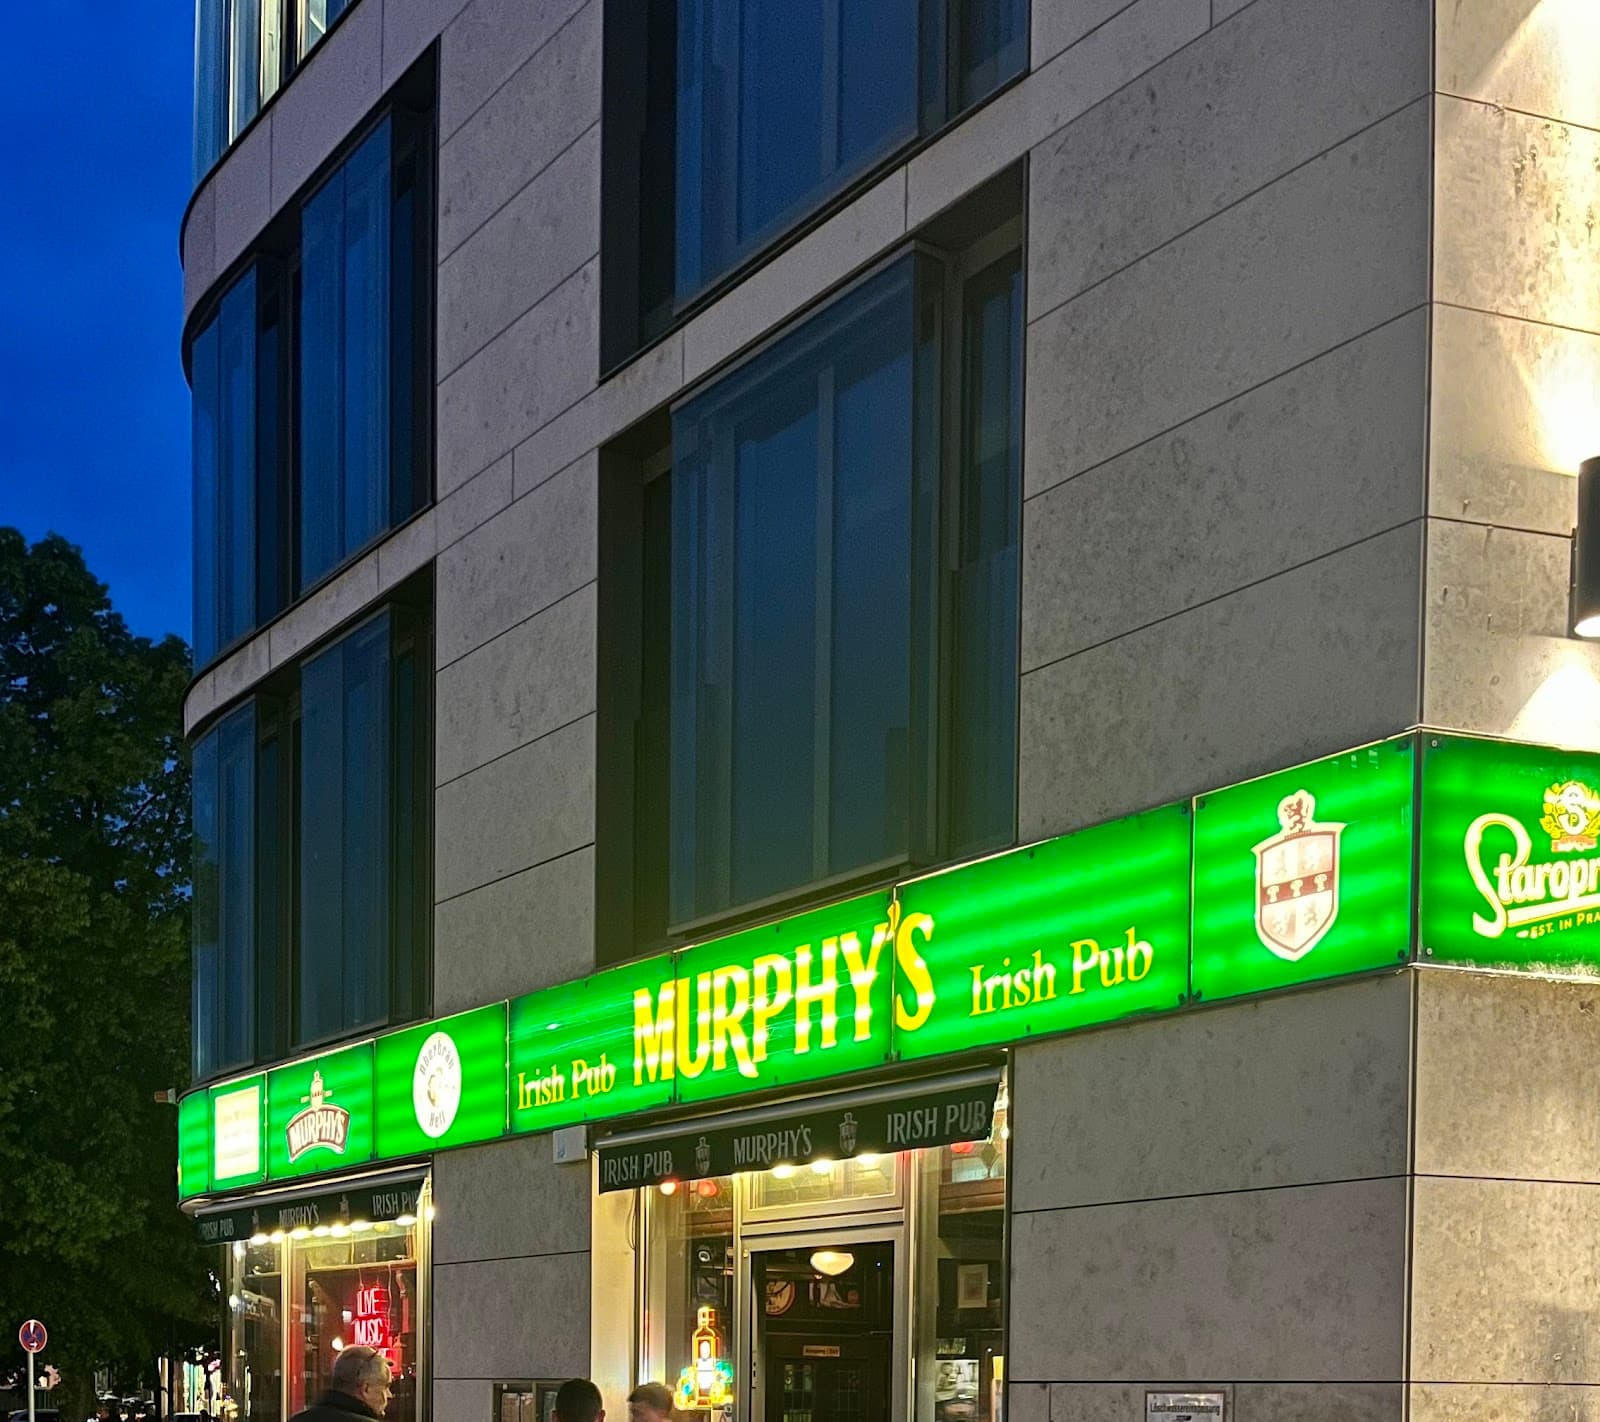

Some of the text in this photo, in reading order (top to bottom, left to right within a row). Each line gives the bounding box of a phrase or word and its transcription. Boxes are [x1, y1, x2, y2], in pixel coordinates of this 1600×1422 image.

[1530, 922, 1554, 939] EST.
[1559, 918, 1572, 931] IN
[518, 900, 1154, 1110] Irish Pub MURPHY'S Irish Pub
[288, 1110, 346, 1154] MURPHY'S
[604, 1100, 986, 1186] IRISH PUB MURPHY'S IRISH PUB
[219, 1218, 234, 1238] PUB
[279, 1202, 320, 1227] MURPHY'S
[372, 1193, 399, 1216] IRISH
